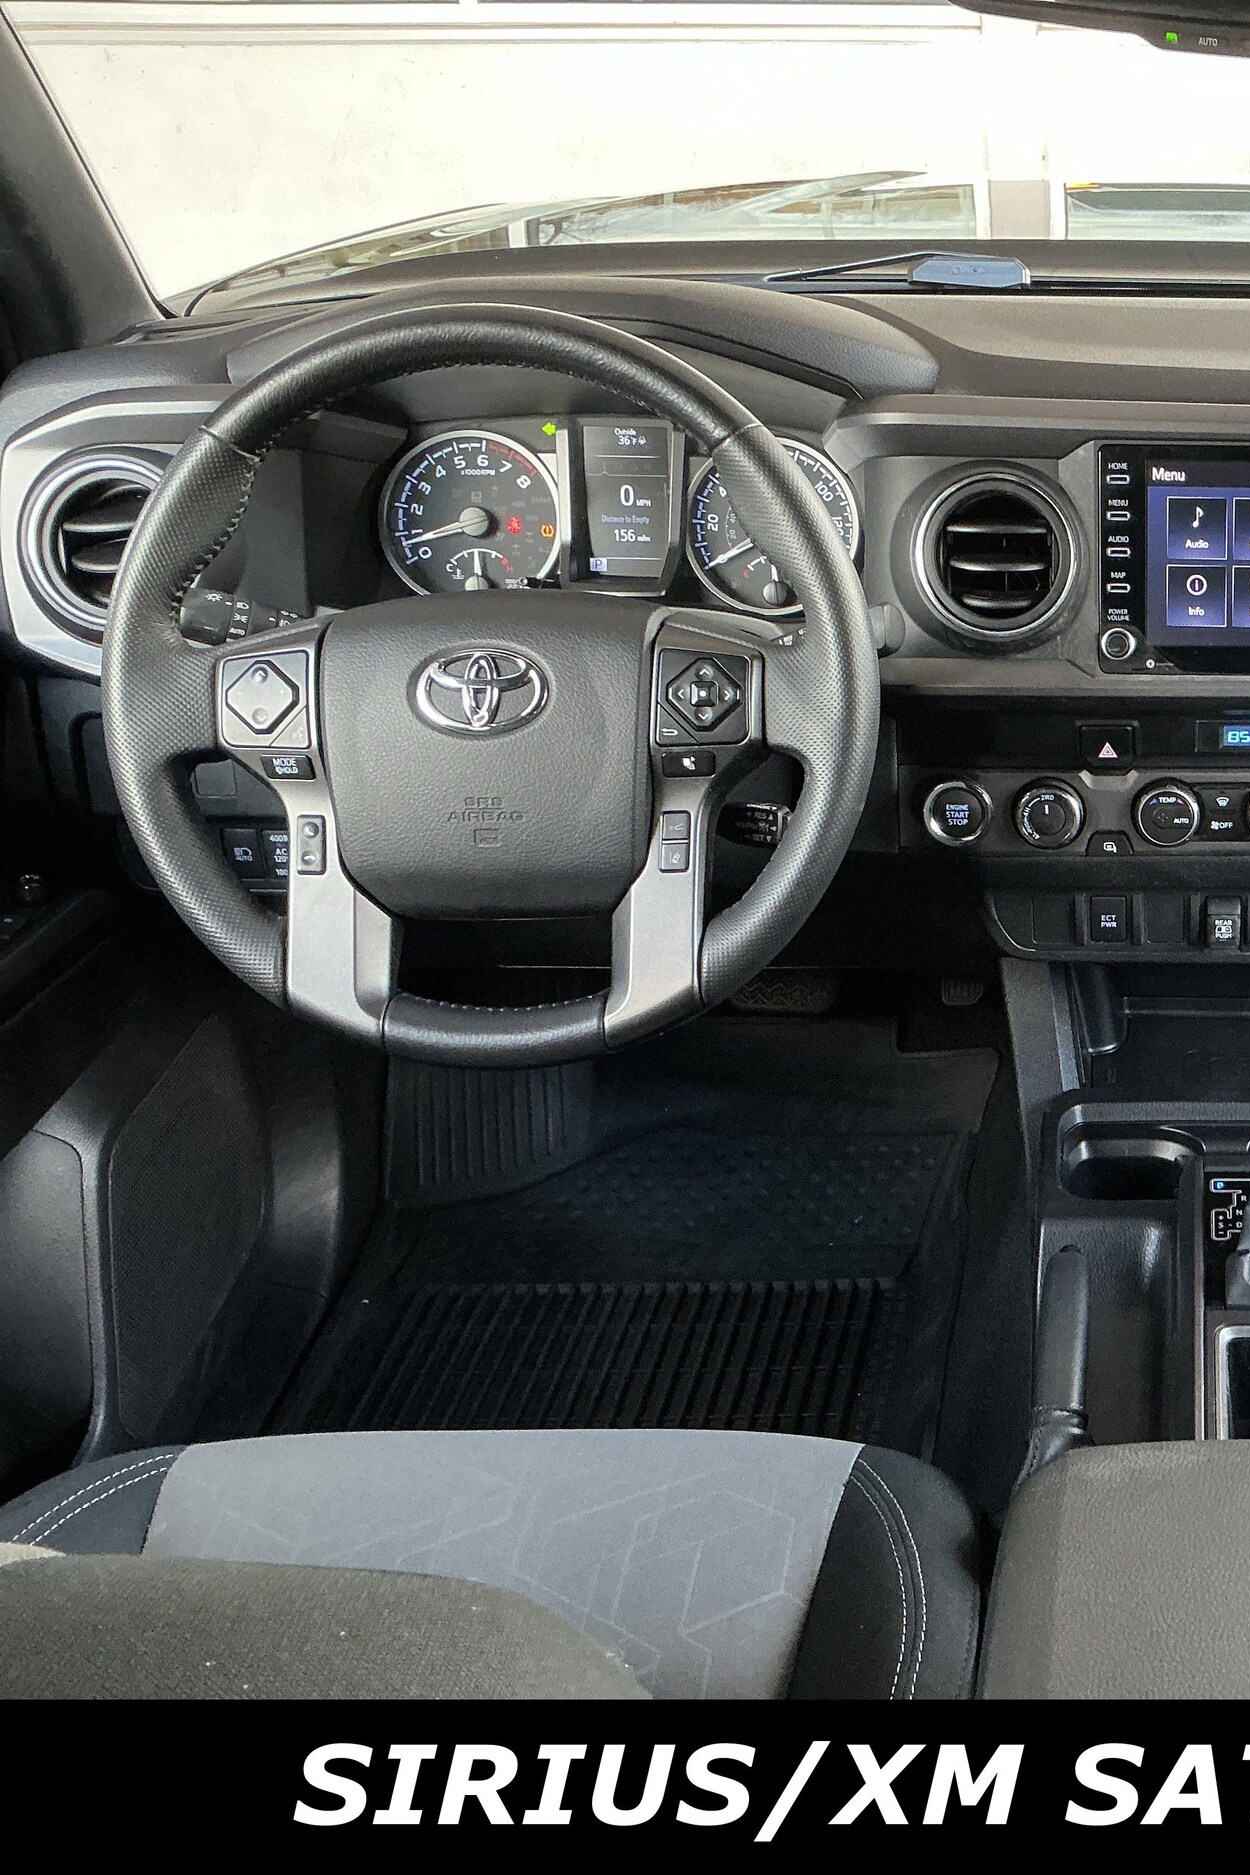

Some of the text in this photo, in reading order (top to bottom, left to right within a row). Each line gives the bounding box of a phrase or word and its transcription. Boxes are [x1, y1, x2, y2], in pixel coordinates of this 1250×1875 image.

[1198, 37, 1218, 46] AUTO
[614, 428, 636, 436] Outside
[453, 455, 466, 469] 5
[477, 455, 489, 467] 6
[499, 460, 513, 473] 7
[434, 465, 447, 478] 4
[1152, 467, 1186, 482] Menu
[516, 474, 531, 489] 8
[418, 481, 432, 495] 3
[814, 481, 834, 502] 100
[620, 484, 651, 507] 0 MPH
[410, 503, 424, 516] 2
[602, 515, 649, 525] Distance to Empty
[707, 513, 719, 532] 20
[614, 529, 636, 542] 156
[1108, 535, 1129, 543] AUDIO
[1185, 539, 1209, 549] Audio
[419, 547, 432, 559] 0
[595, 559, 603, 569] P
[1188, 606, 1205, 616] Info
[1227, 731, 1250, 743] 85
[273, 758, 297, 767] MODE
[447, 811, 524, 822] AIRBAG
